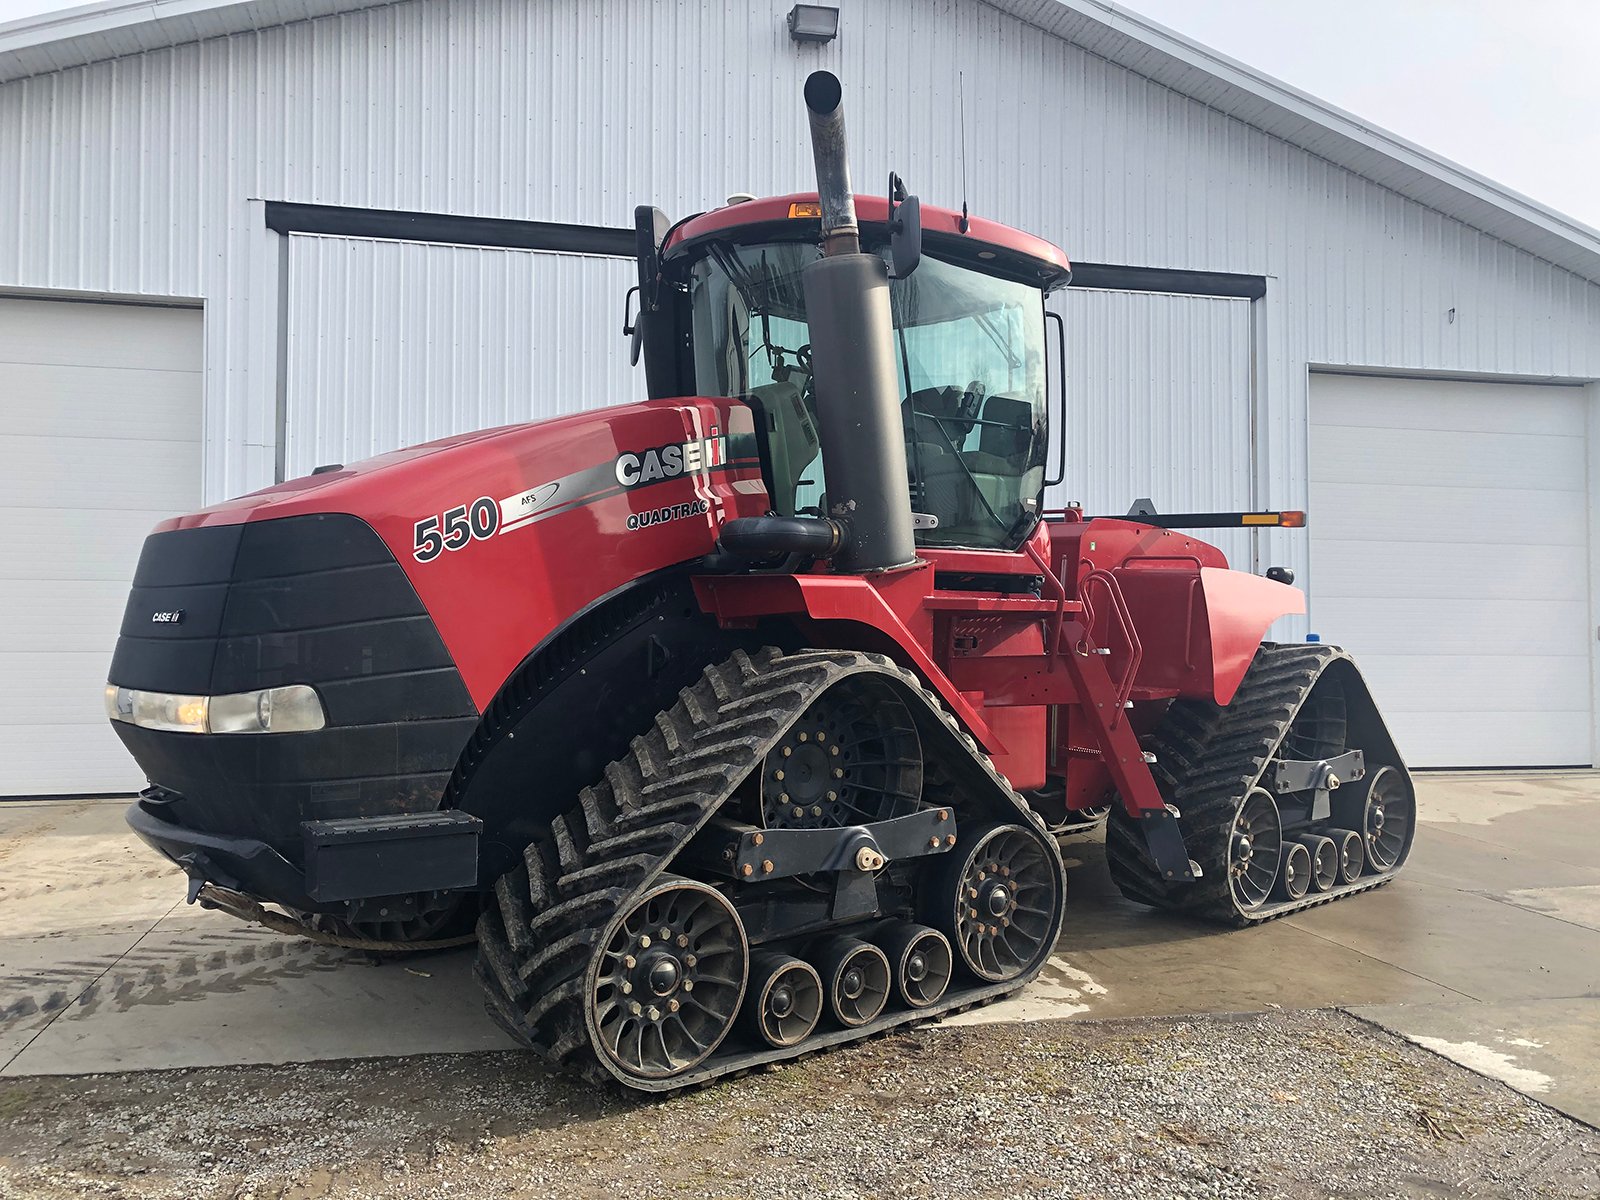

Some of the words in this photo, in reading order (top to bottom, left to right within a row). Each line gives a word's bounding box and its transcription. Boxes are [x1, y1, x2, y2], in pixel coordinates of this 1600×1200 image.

[615, 442, 701, 486] CASE
[521, 494, 537, 506] AFS
[626, 499, 710, 531] QUADTRAC
[412, 496, 499, 563] 550
[152, 612, 171, 622] CASE
